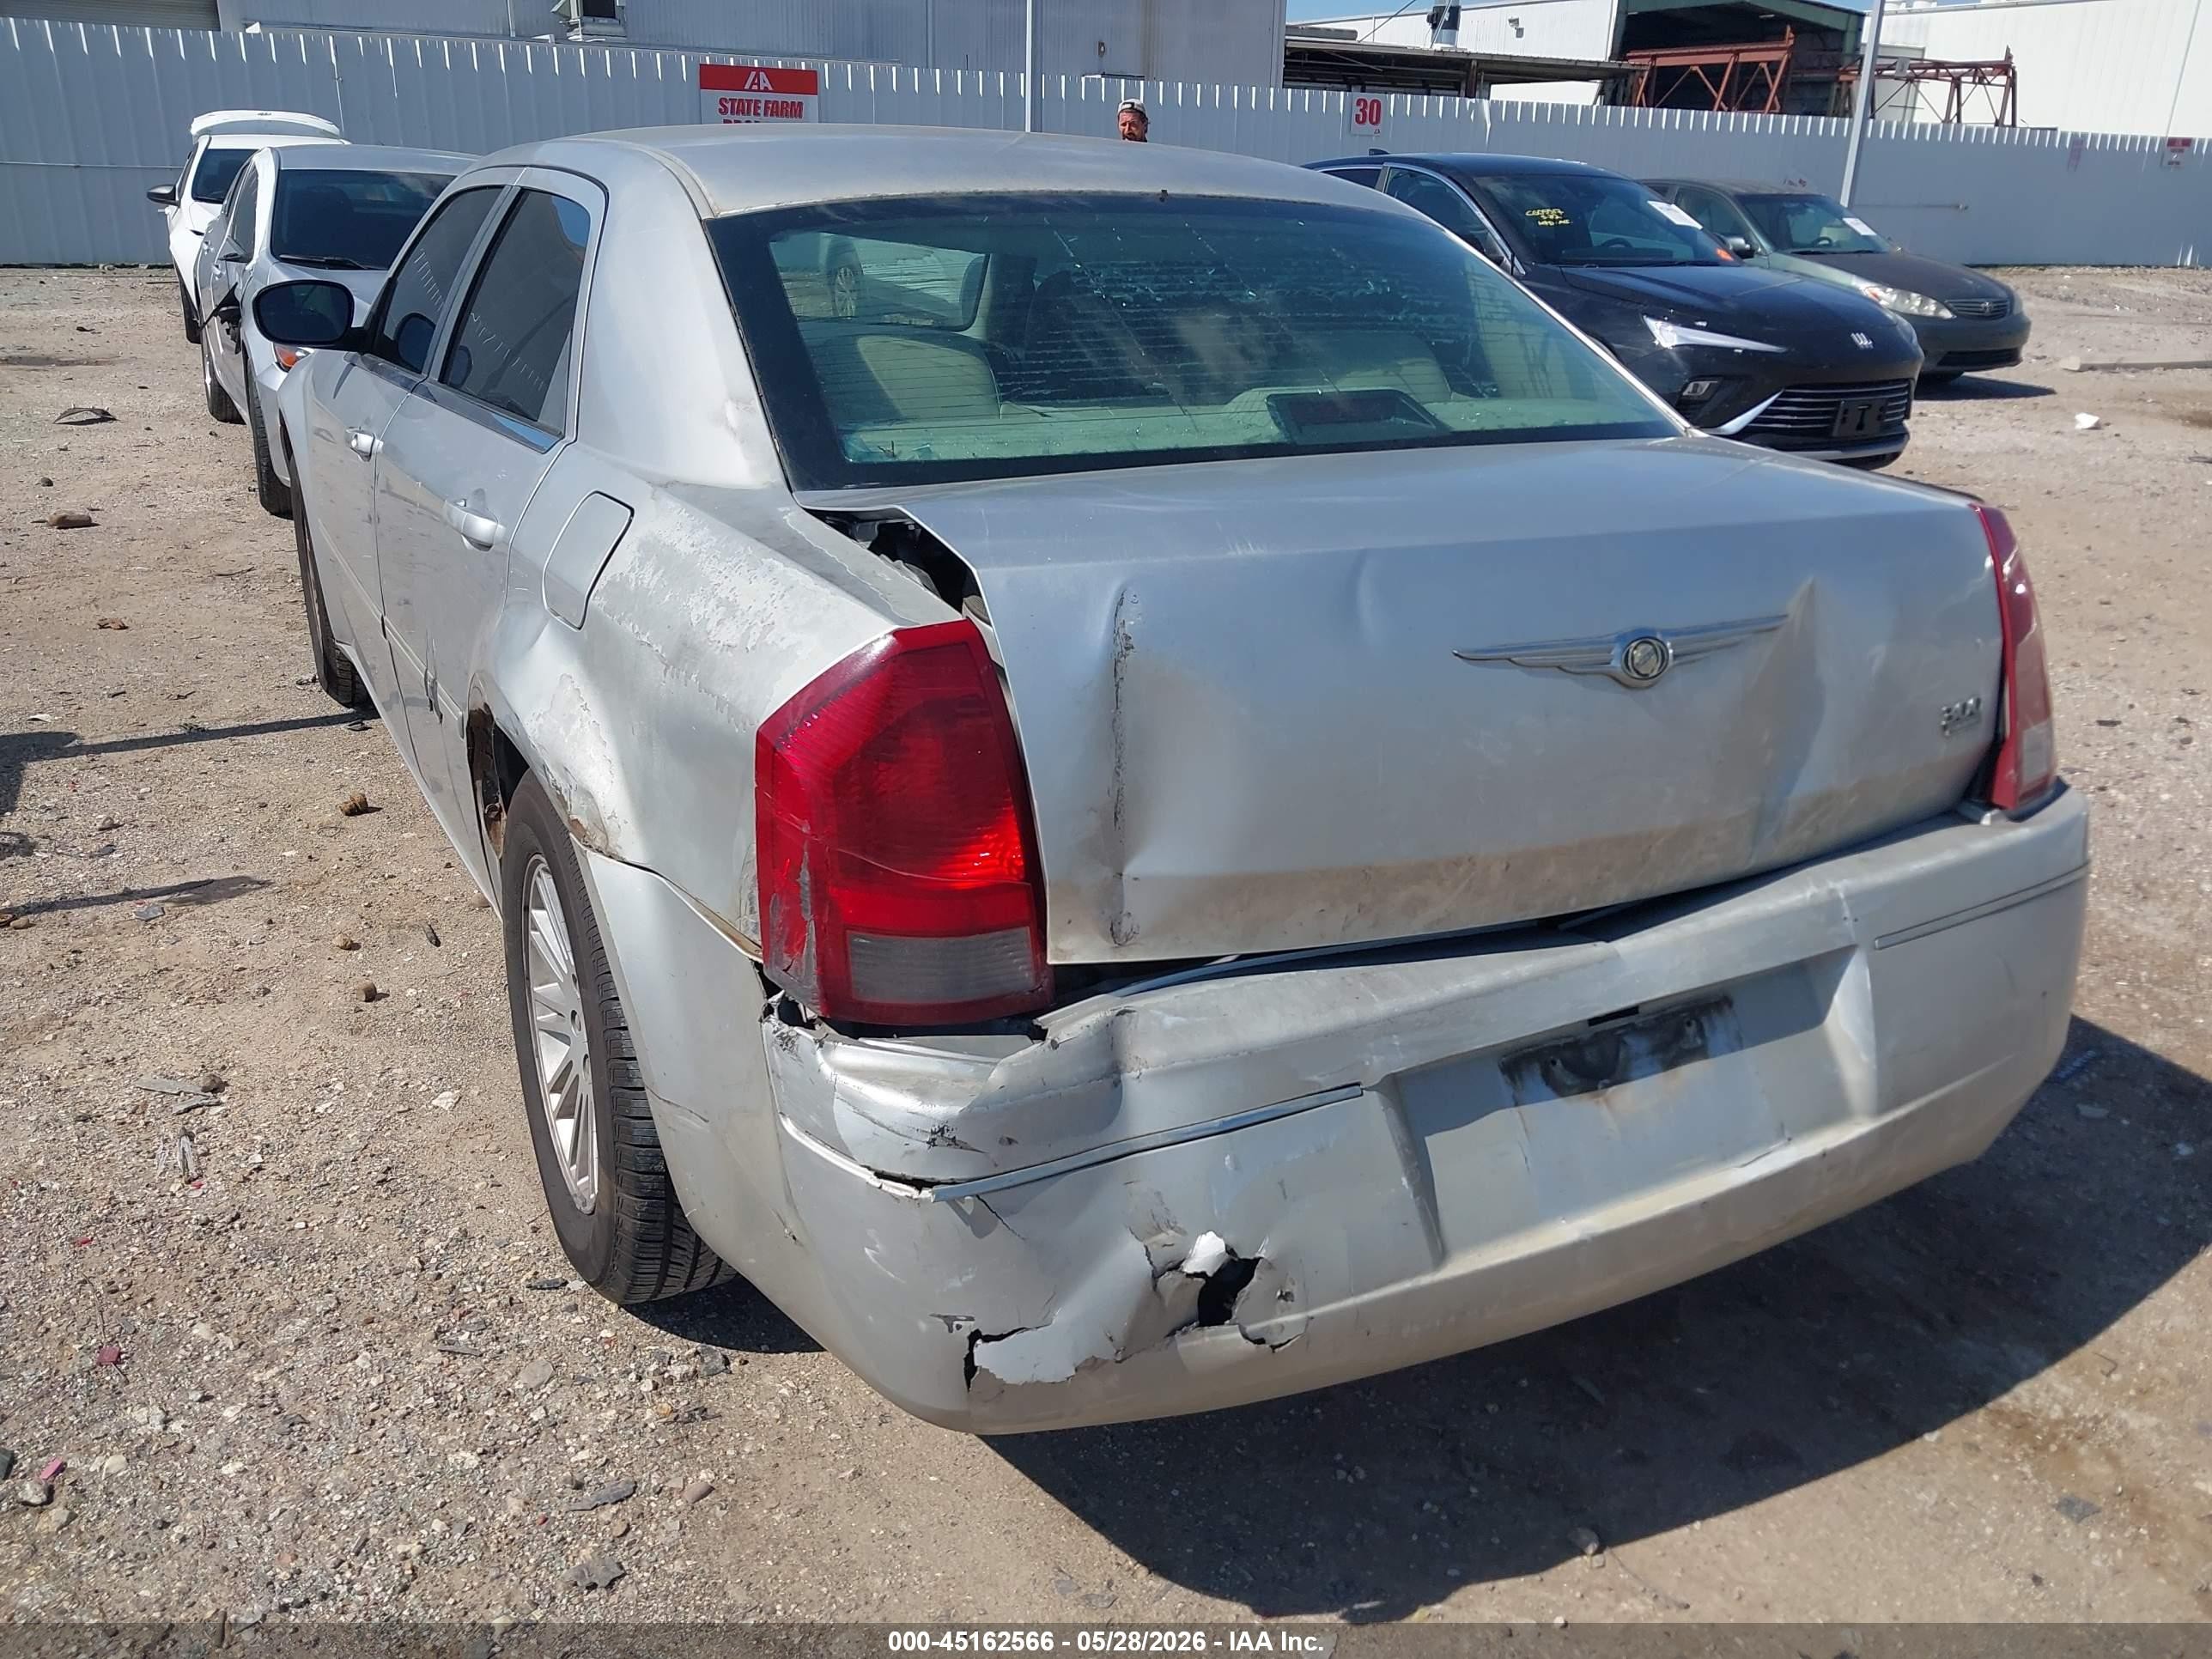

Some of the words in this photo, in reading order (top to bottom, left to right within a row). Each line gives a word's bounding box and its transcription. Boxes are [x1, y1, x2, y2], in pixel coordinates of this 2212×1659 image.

[718, 97, 761, 116] STATE
[763, 99, 804, 119] FARM
[1355, 98, 1382, 125] 30
